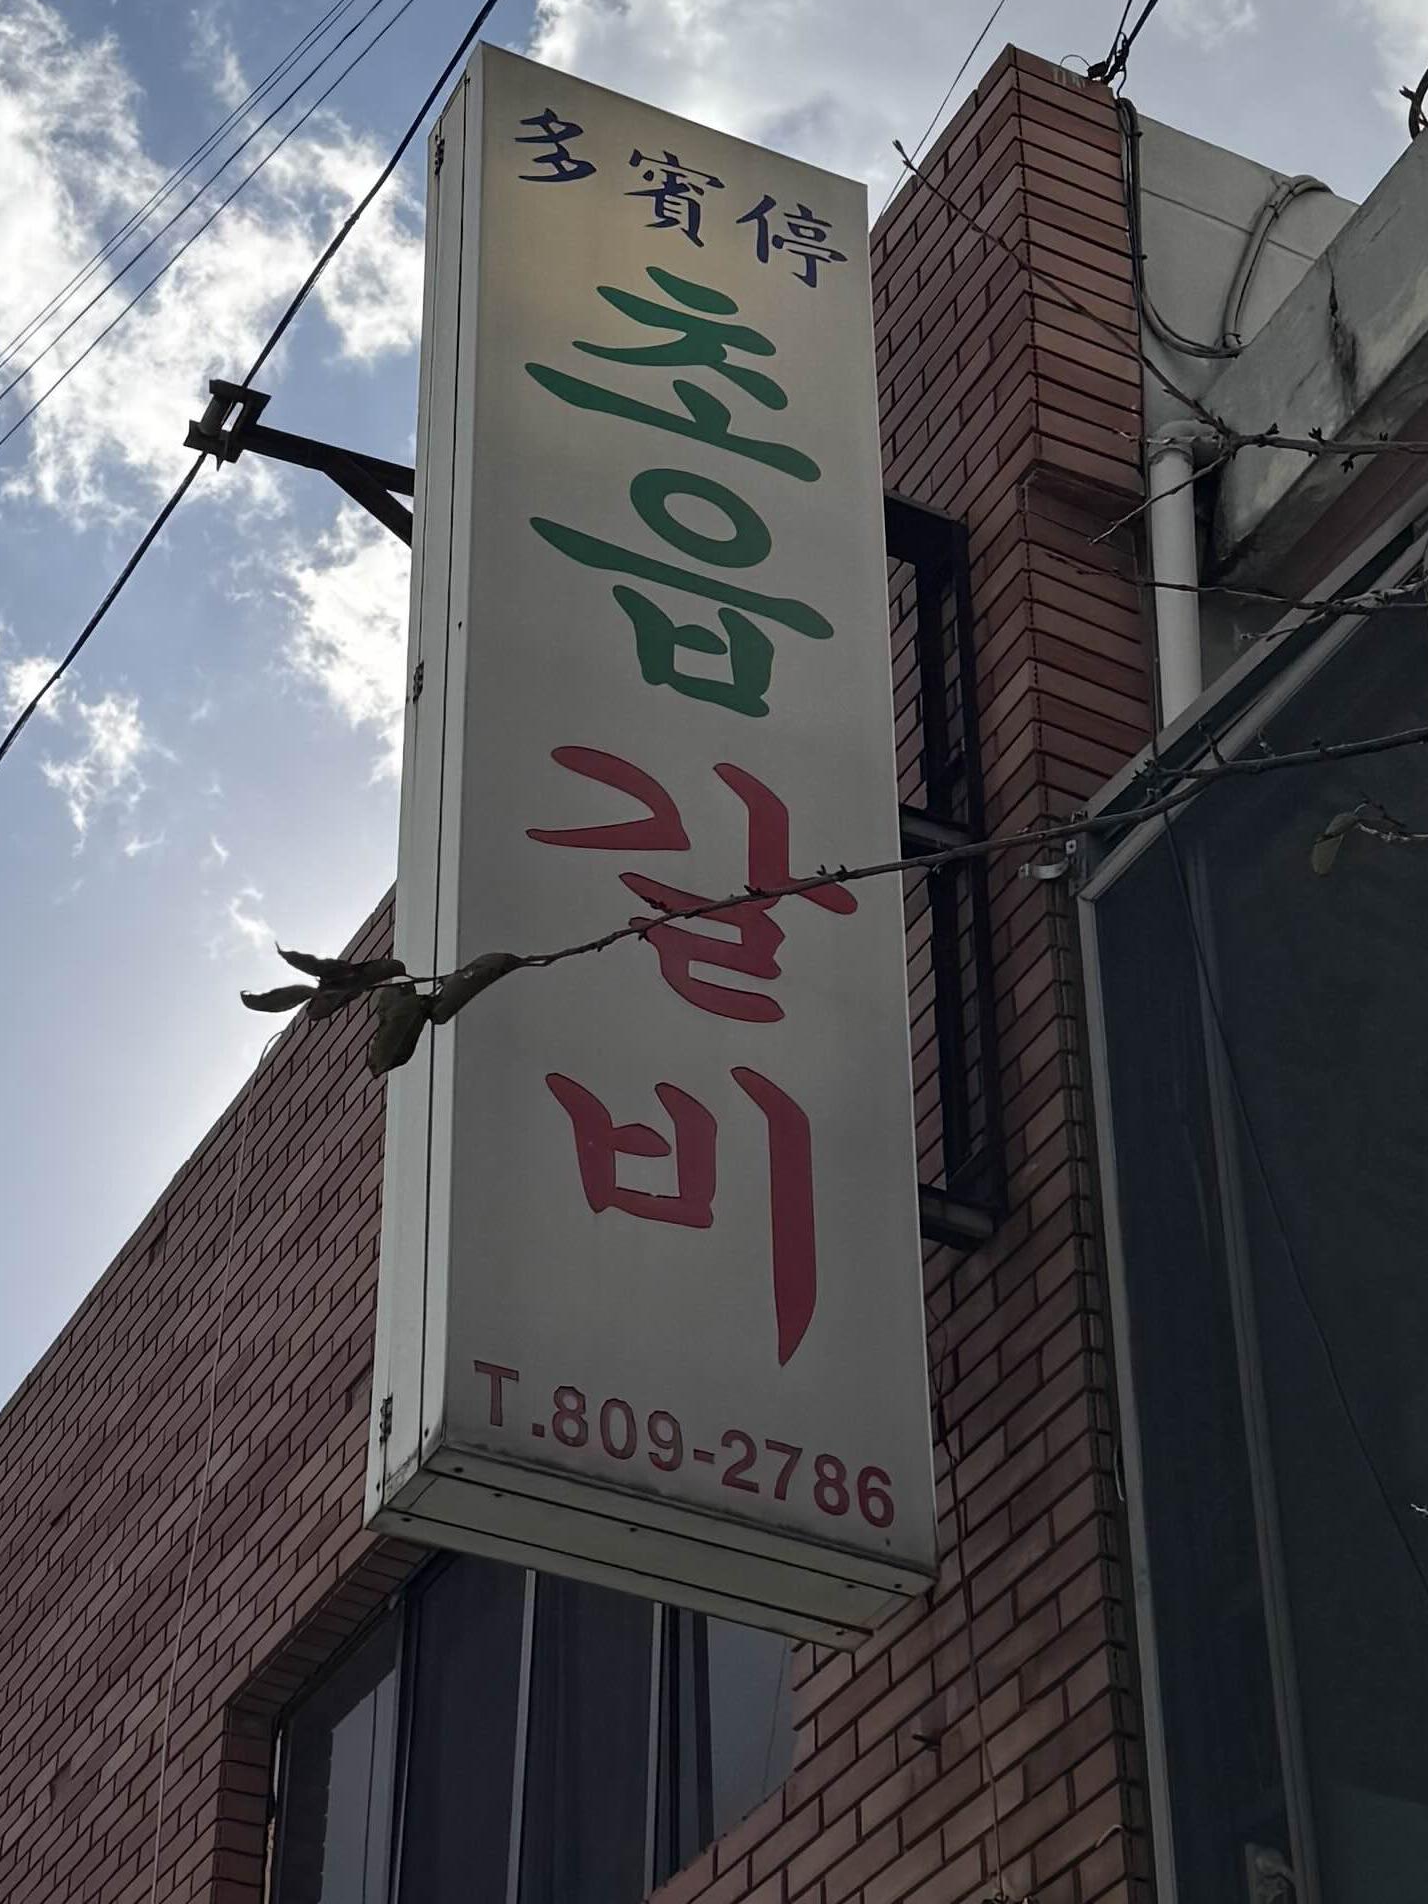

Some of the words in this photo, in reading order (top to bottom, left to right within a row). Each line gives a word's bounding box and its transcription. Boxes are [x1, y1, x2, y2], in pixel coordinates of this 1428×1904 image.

[513, 107, 849, 289] 多賓停
[473, 1360, 896, 1529] T.809-2786
